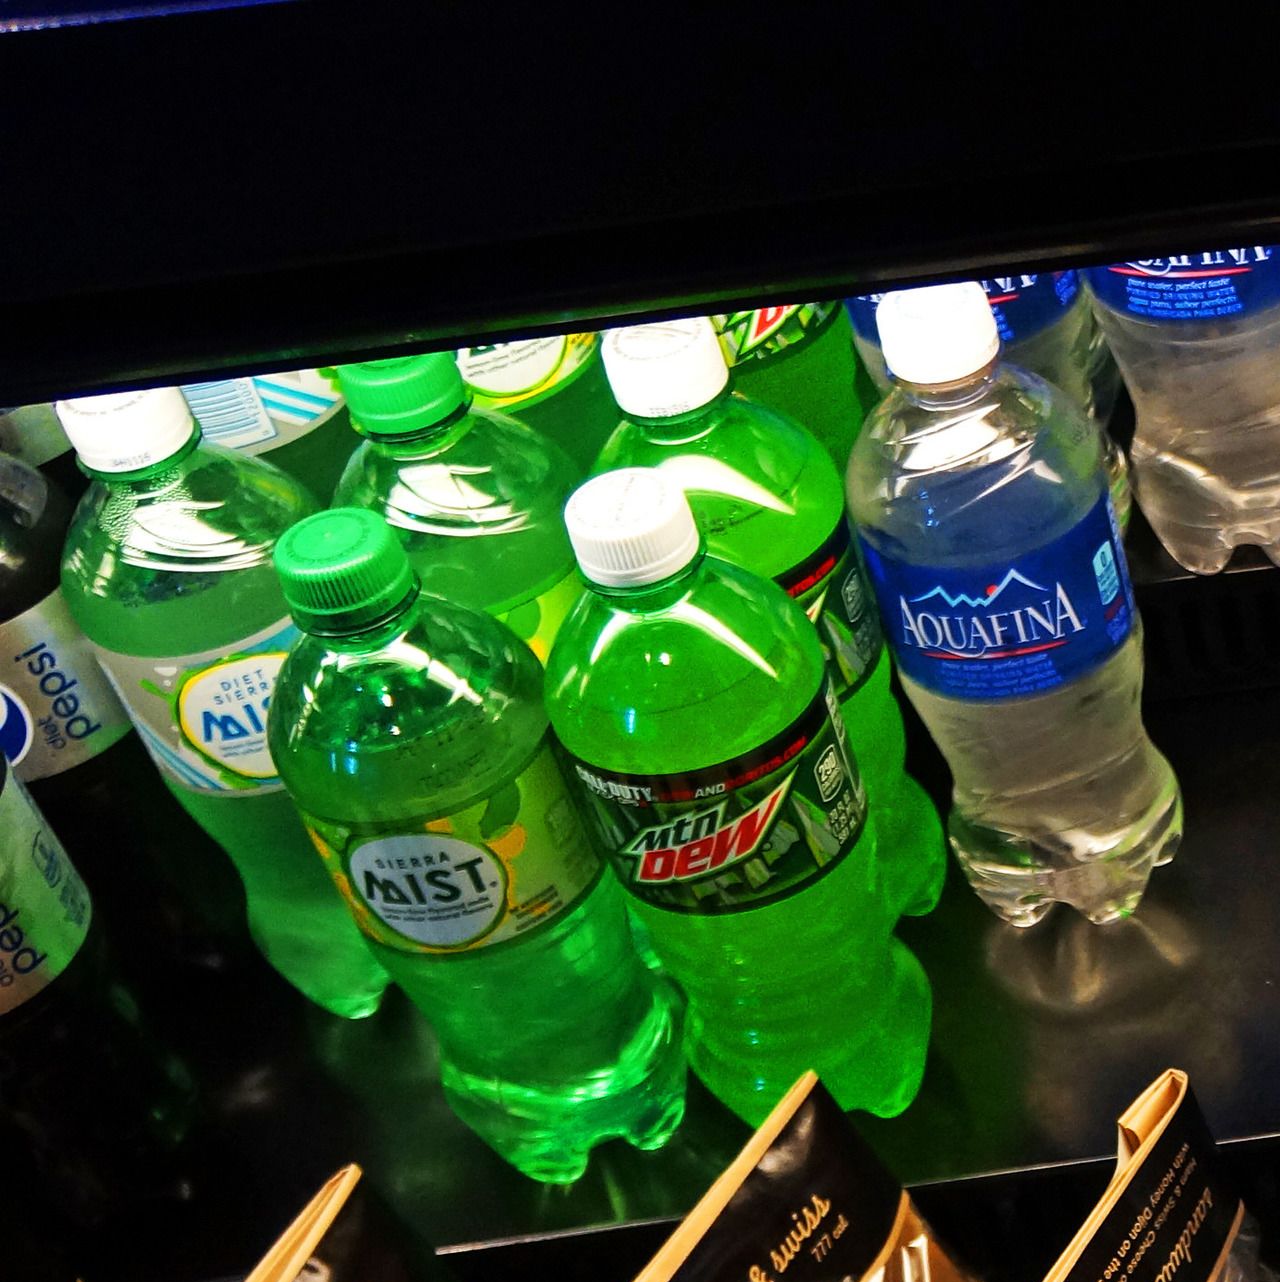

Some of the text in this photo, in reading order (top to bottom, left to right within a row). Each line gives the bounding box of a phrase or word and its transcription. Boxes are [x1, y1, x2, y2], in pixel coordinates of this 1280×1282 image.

[899, 581, 1086, 656] AQUAFINA
[15, 642, 101, 740] pepsi
[220, 669, 266, 692] DIET
[34, 717, 67, 750] diet
[695, 784, 725, 799] AND
[374, 851, 450, 870] SIERRA
[363, 857, 484, 905] MIST
[1150, 1167, 1175, 1208] Honey
[769, 1194, 832, 1273] swiss
[810, 1216, 850, 1263] 777 cal
[1127, 1206, 1153, 1241] Dijon
[1117, 1239, 1131, 1259] on
[1127, 1231, 1156, 1273] Cheese
[1103, 1256, 1122, 1281] the
